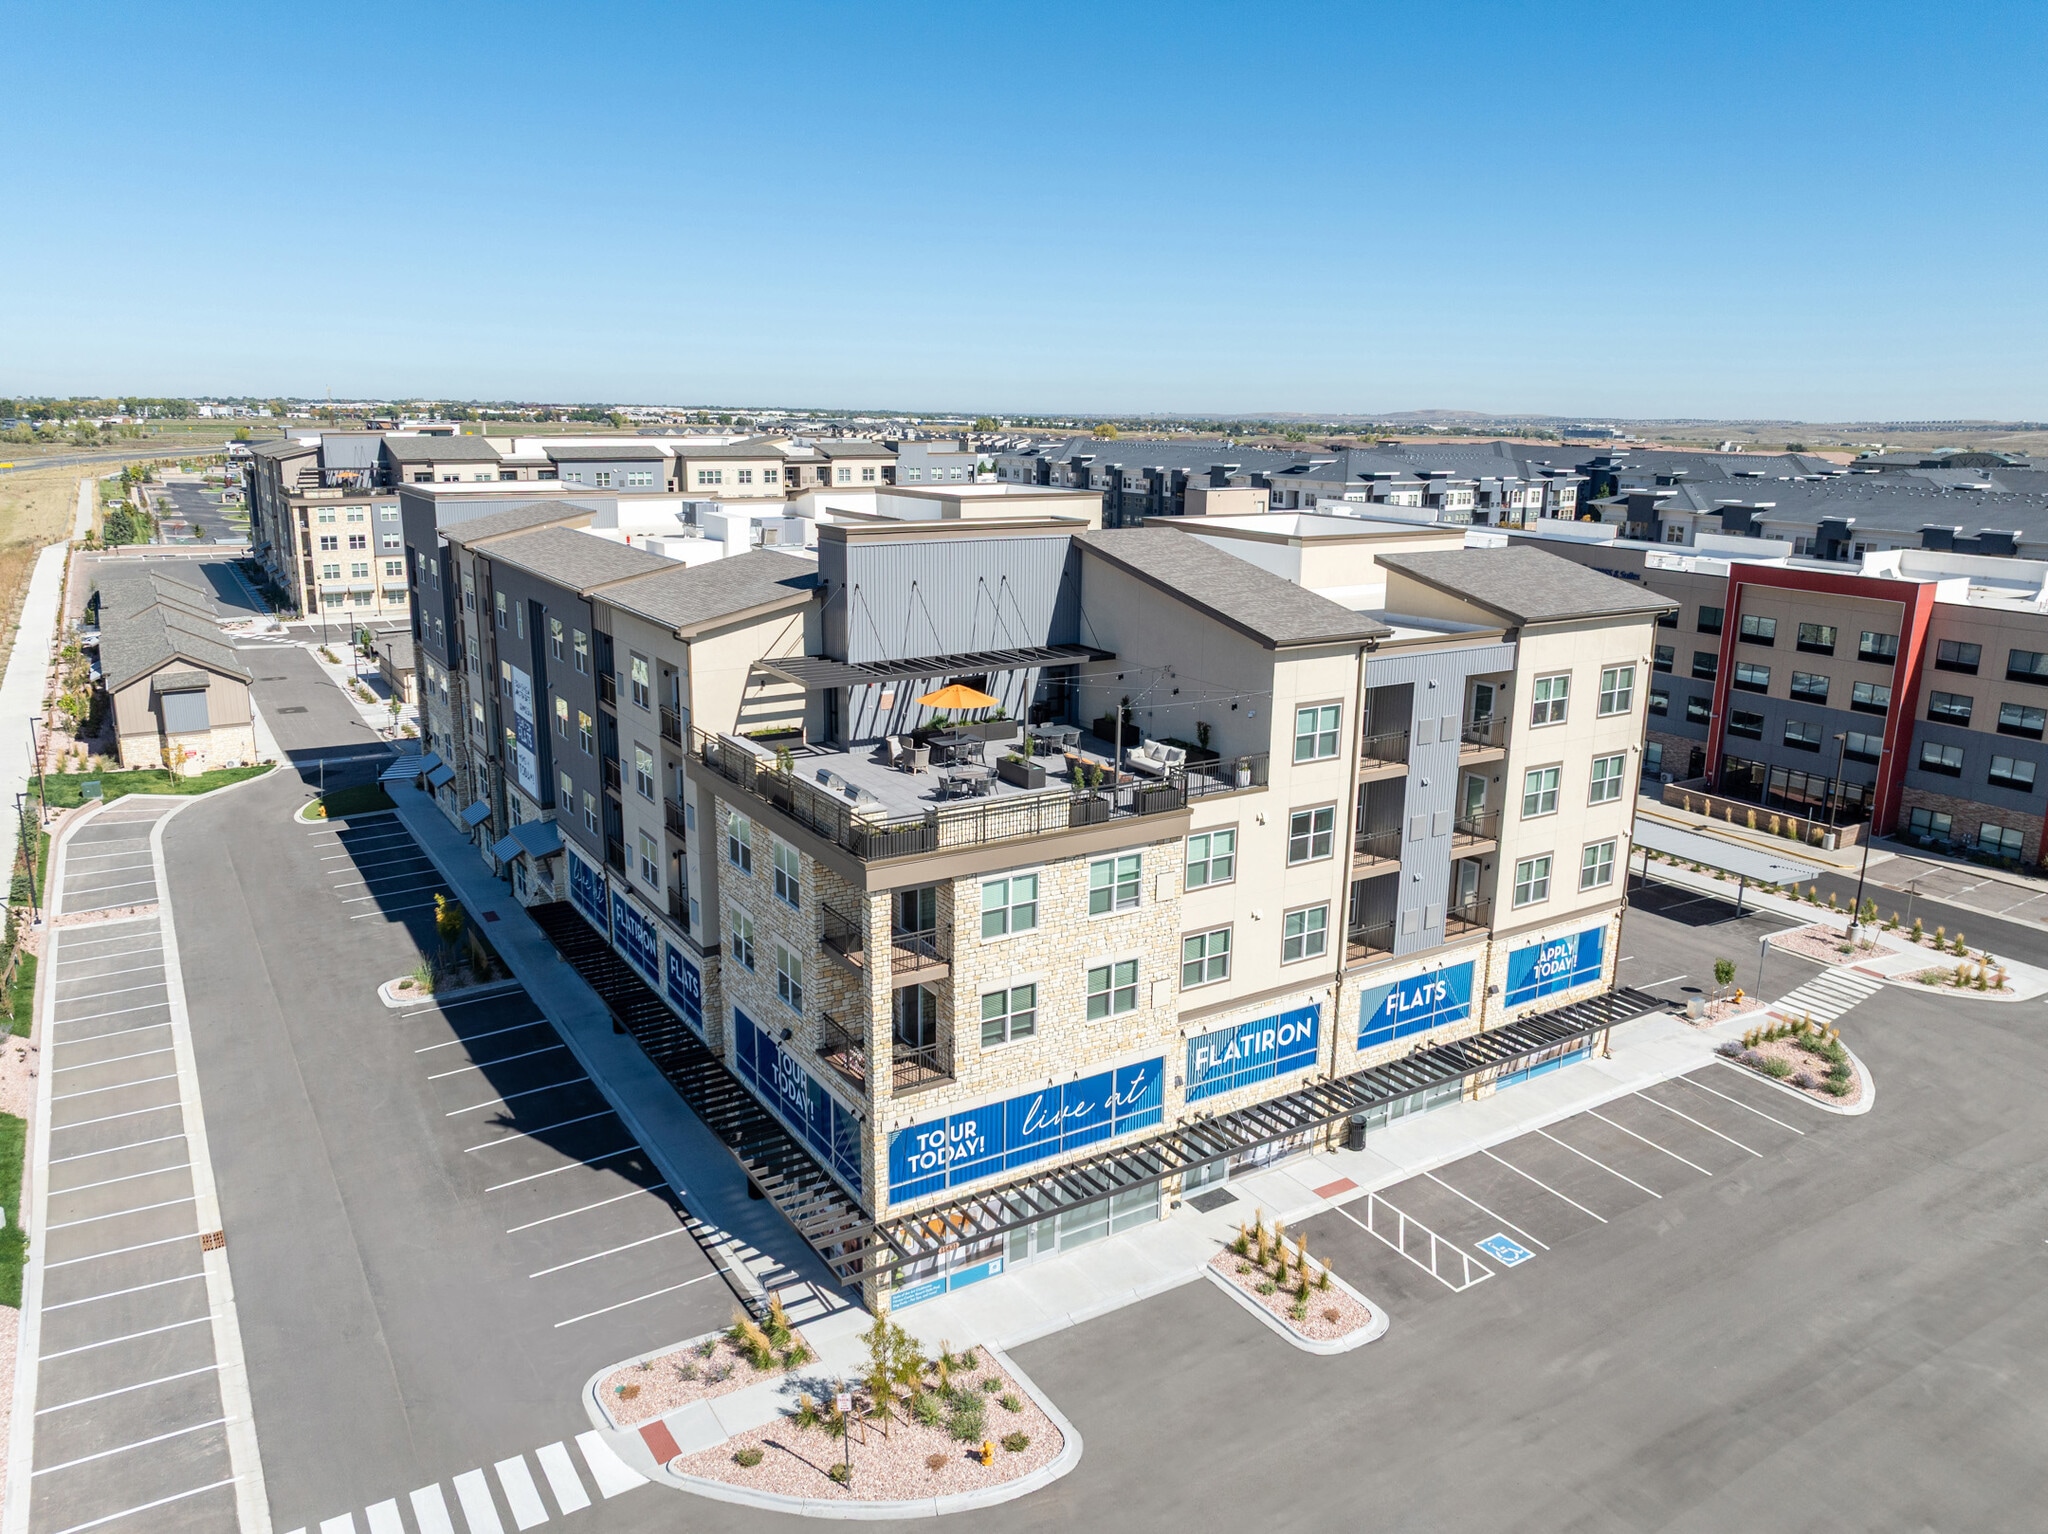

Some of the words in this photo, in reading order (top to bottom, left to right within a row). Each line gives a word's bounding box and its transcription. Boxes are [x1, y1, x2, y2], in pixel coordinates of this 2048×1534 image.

[616, 903, 657, 958] FLATIRON
[1538, 941, 1576, 963] APPLY
[670, 954, 699, 998] FLATS
[1533, 954, 1578, 980] TODAY!
[1386, 980, 1447, 1016] FLATS
[1195, 1017, 1312, 1071] FLATIRON
[775, 1045, 807, 1092] TOUR
[771, 1062, 814, 1121] TODAY!
[1022, 1094, 1096, 1135] live
[1104, 1068, 1148, 1109] at
[907, 1135, 985, 1173] TODAY!
[916, 1120, 977, 1152] TOUR
